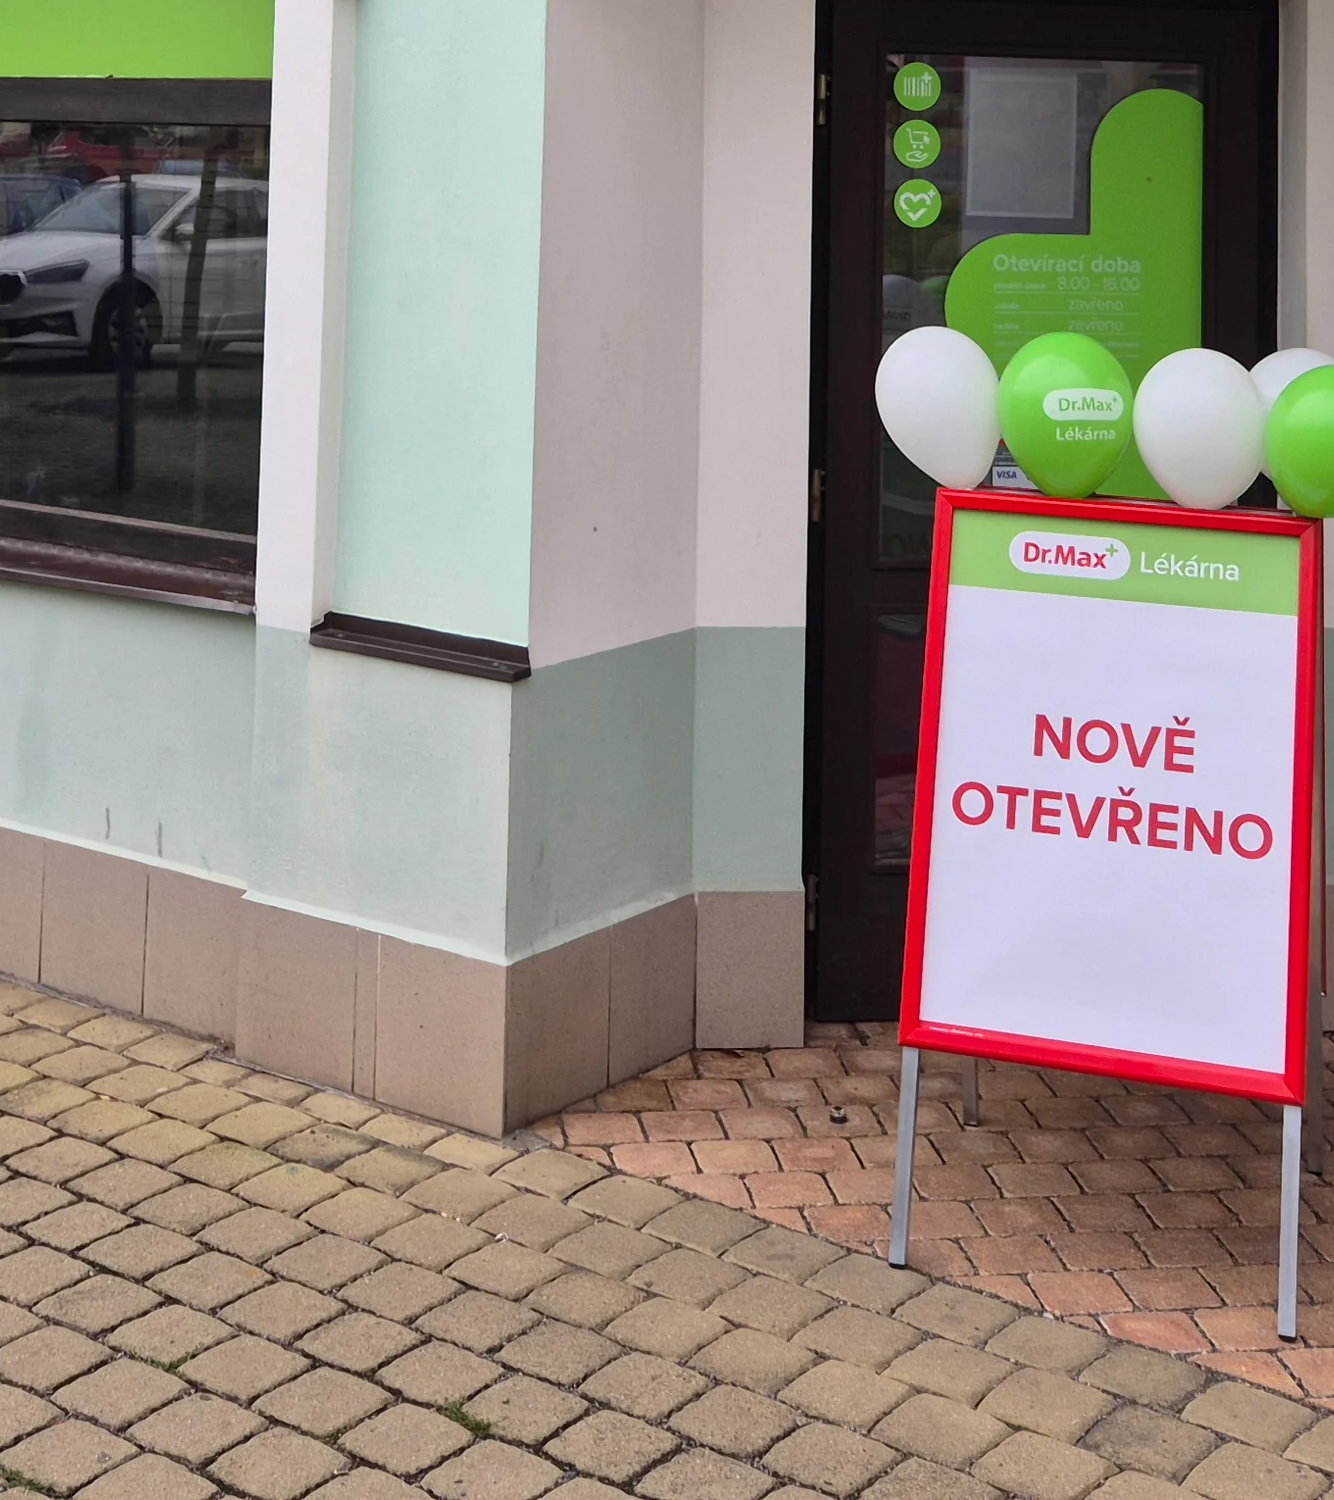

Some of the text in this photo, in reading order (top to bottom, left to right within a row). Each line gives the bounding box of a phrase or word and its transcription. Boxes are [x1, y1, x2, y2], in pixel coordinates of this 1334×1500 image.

[993, 254, 1141, 273] Otevírací doba
[1057, 276, 1090, 290] 8.00
[1103, 277, 1140, 291] 16.00
[1056, 426, 1116, 441] Lékárna
[996, 470, 1017, 479] VISA
[1140, 552, 1240, 581] Lékárna
[1033, 713, 1195, 774] NOVĚ
[952, 781, 1273, 861] OTEVŘENO
